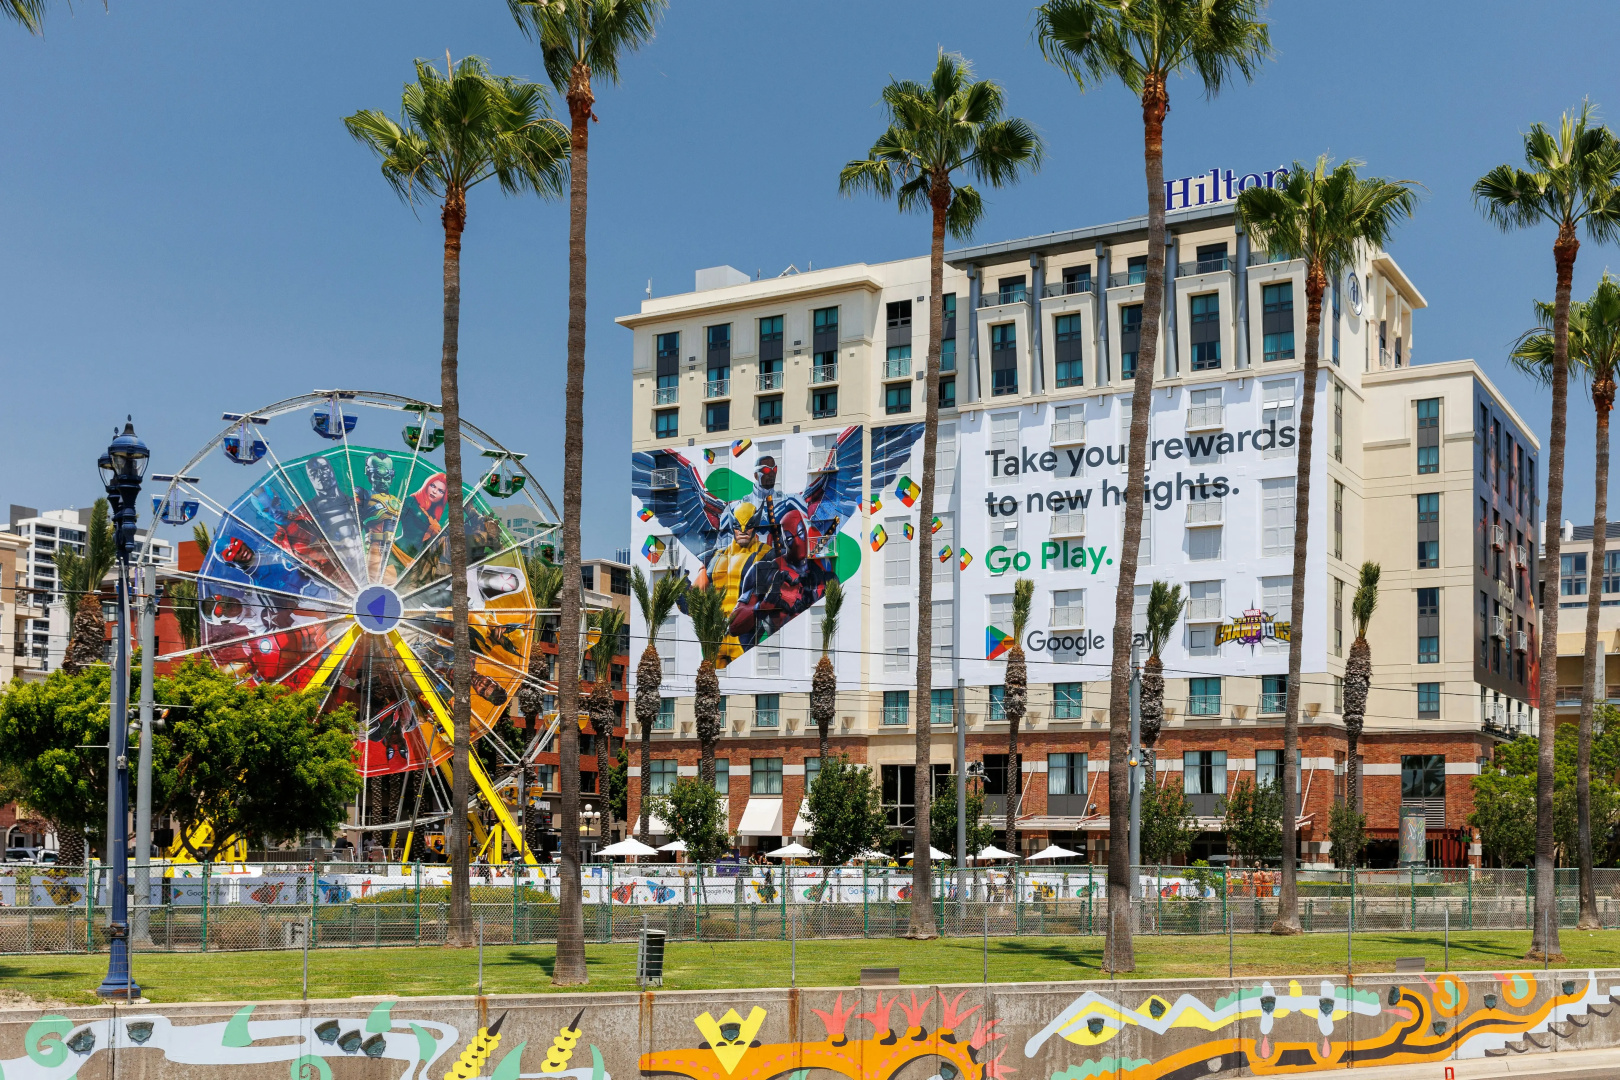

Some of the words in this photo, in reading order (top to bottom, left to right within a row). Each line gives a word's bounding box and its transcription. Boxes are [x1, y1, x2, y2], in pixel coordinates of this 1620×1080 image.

[985, 446, 1058, 477] Take
[1067, 444, 1126, 477] you
[1151, 419, 1296, 460] rewards
[985, 492, 1018, 518] to
[1026, 489, 1093, 513] new
[985, 545, 1031, 574] Go
[1041, 540, 1113, 575] Play.
[1026, 629, 1105, 656] Google
[1214, 617, 1291, 647] CHAMPIONS
